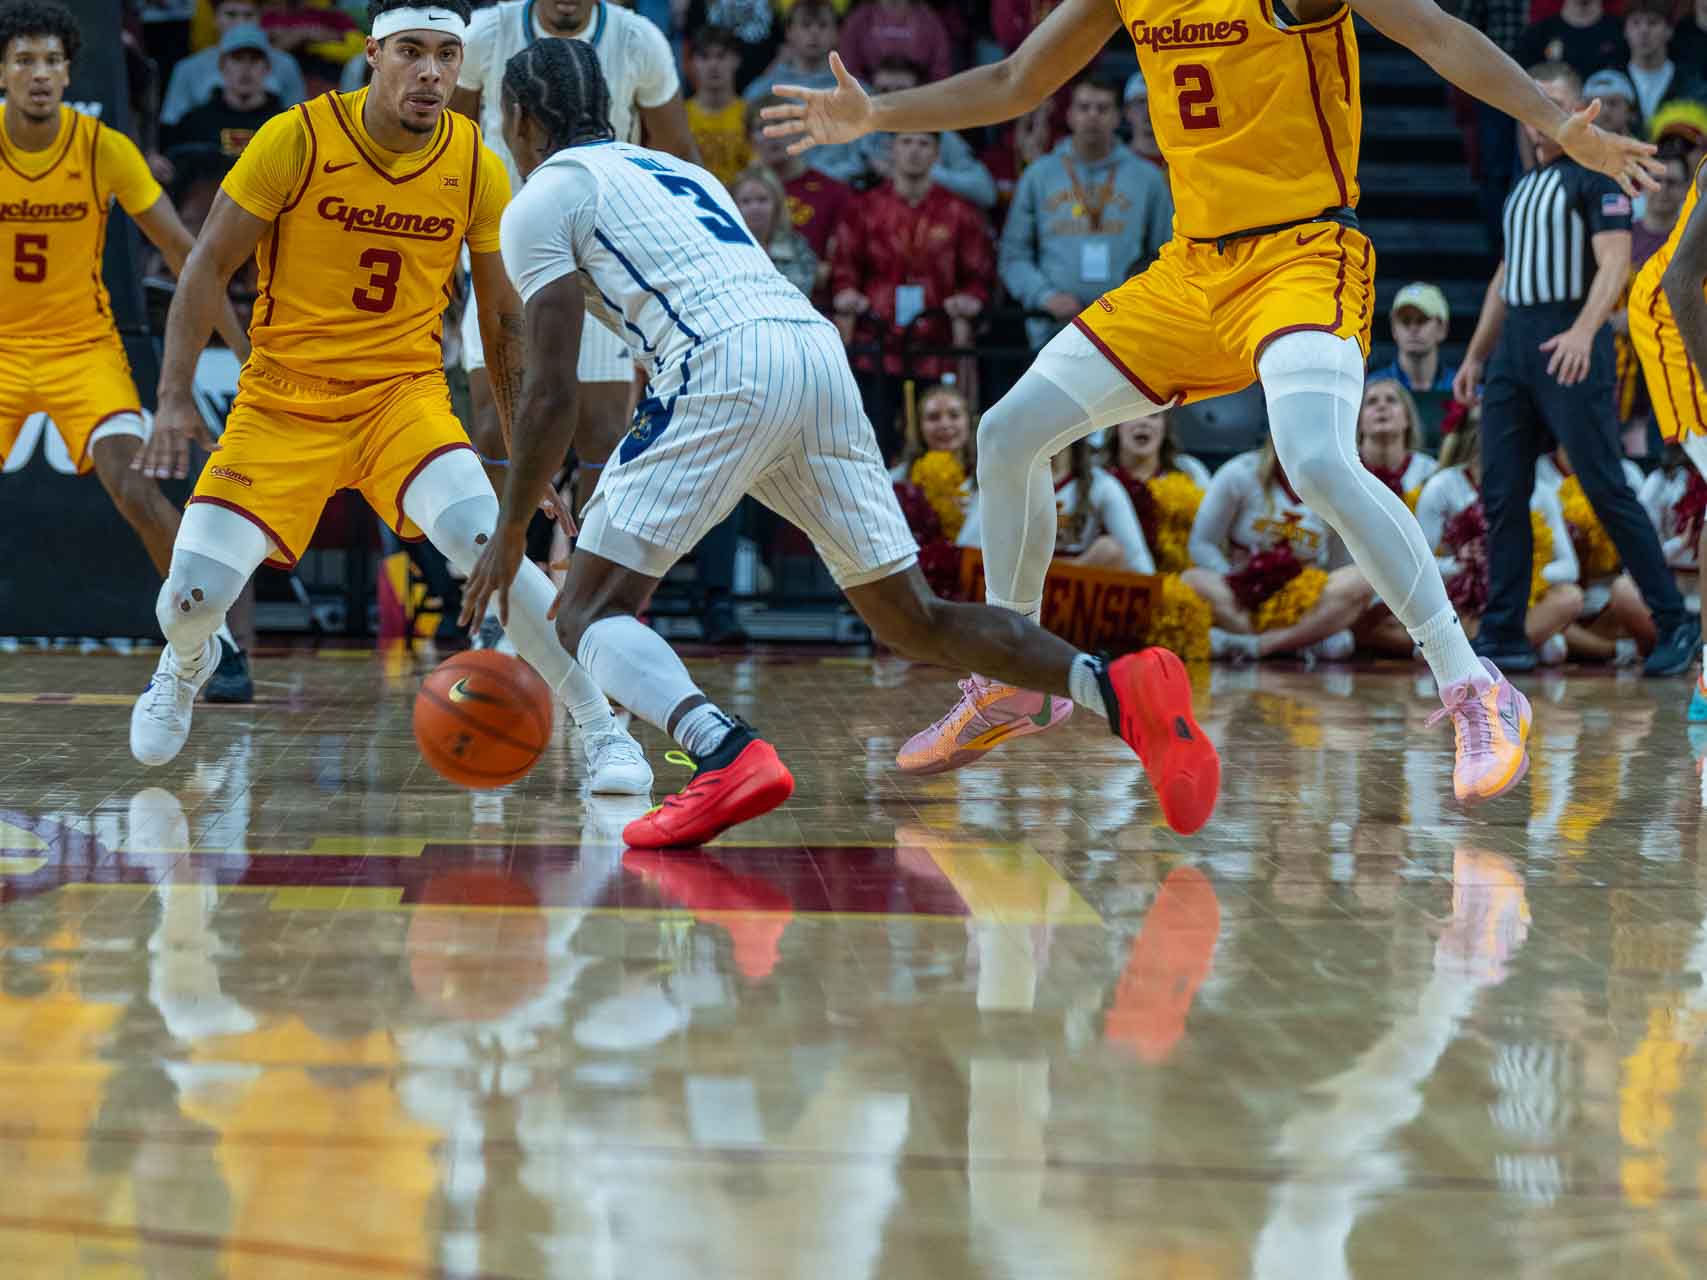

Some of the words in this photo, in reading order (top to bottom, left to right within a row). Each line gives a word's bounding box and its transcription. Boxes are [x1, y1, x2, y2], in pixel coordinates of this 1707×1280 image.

[1131, 18, 1249, 53] Cyclones
[1173, 63, 1221, 130] 2
[0, 198, 89, 223] yclones
[317, 195, 456, 242] Cyclones
[652, 173, 755, 247] 3
[14, 233, 49, 284] 5
[351, 247, 402, 313] 3
